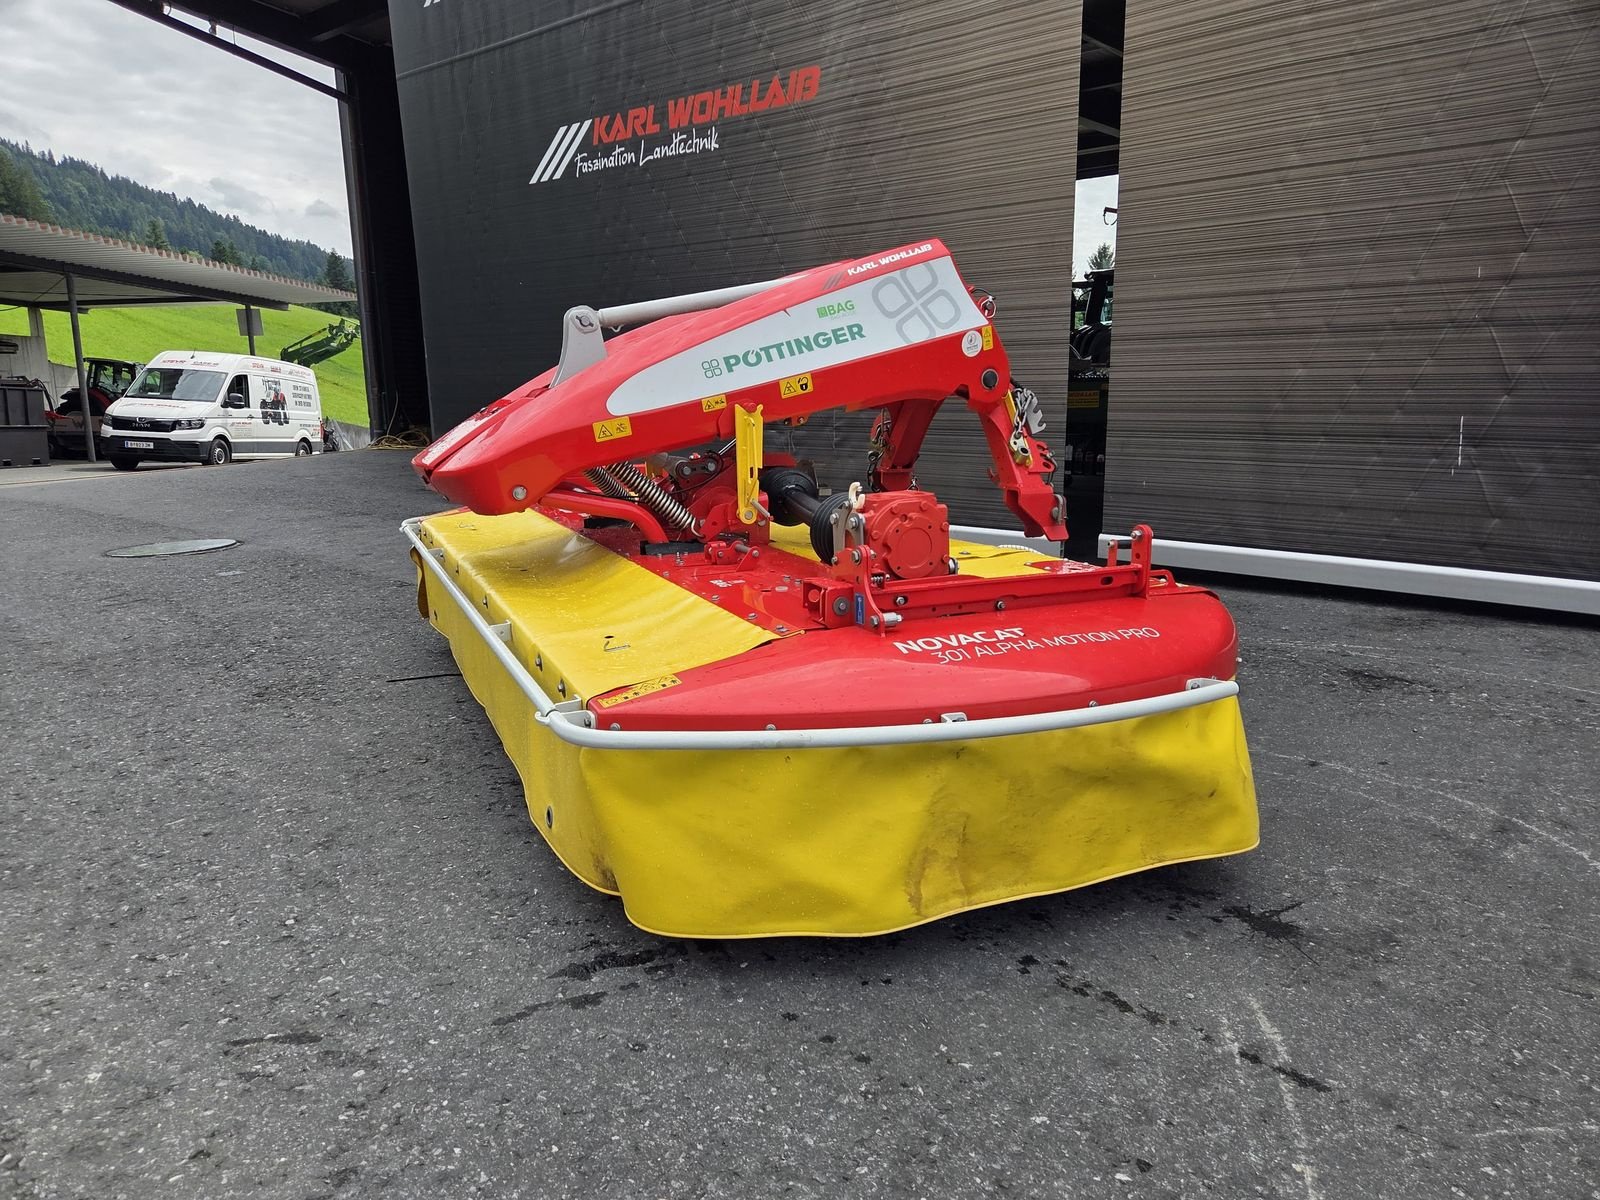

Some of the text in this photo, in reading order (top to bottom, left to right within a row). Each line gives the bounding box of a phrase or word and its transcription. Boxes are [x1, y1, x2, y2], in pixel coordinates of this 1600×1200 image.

[593, 64, 821, 146] KARL WOHLLAIB
[575, 126, 720, 178] Faszination Landtechnik
[847, 261, 879, 276] KARL
[827, 300, 855, 316] BAG
[893, 627, 1025, 654] NOVACAT
[930, 627, 1160, 665] 301 ALPHA MOTION PRO
